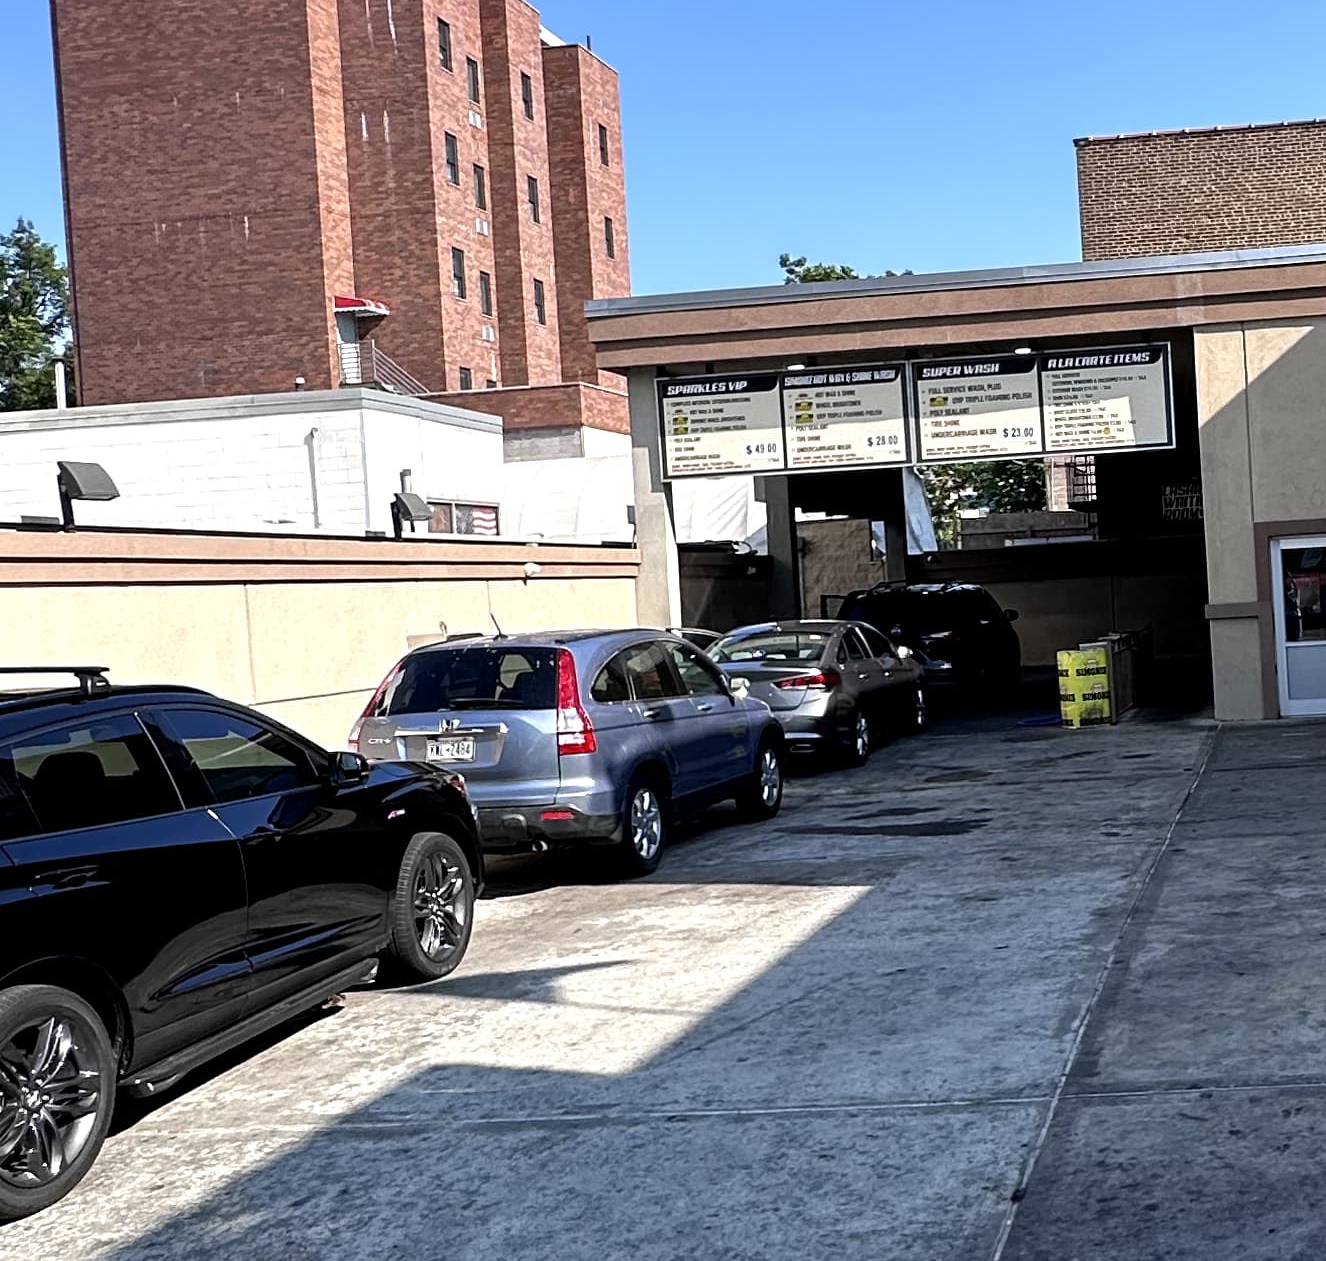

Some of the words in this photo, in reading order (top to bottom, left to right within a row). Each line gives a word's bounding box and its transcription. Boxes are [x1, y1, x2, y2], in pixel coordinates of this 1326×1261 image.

[1074, 355, 1113, 367] CARTE
[1114, 351, 1151, 364] ITEMS
[922, 366, 961, 378] SUPER
[963, 363, 1000, 374] WASH
[666, 382, 727, 395] SPARKLES
[728, 380, 748, 392] VIP
[1002, 428, 1009, 438] $
[1011, 427, 1034, 438] 23.00
[867, 437, 874, 447] $
[746, 445, 752, 455] $
